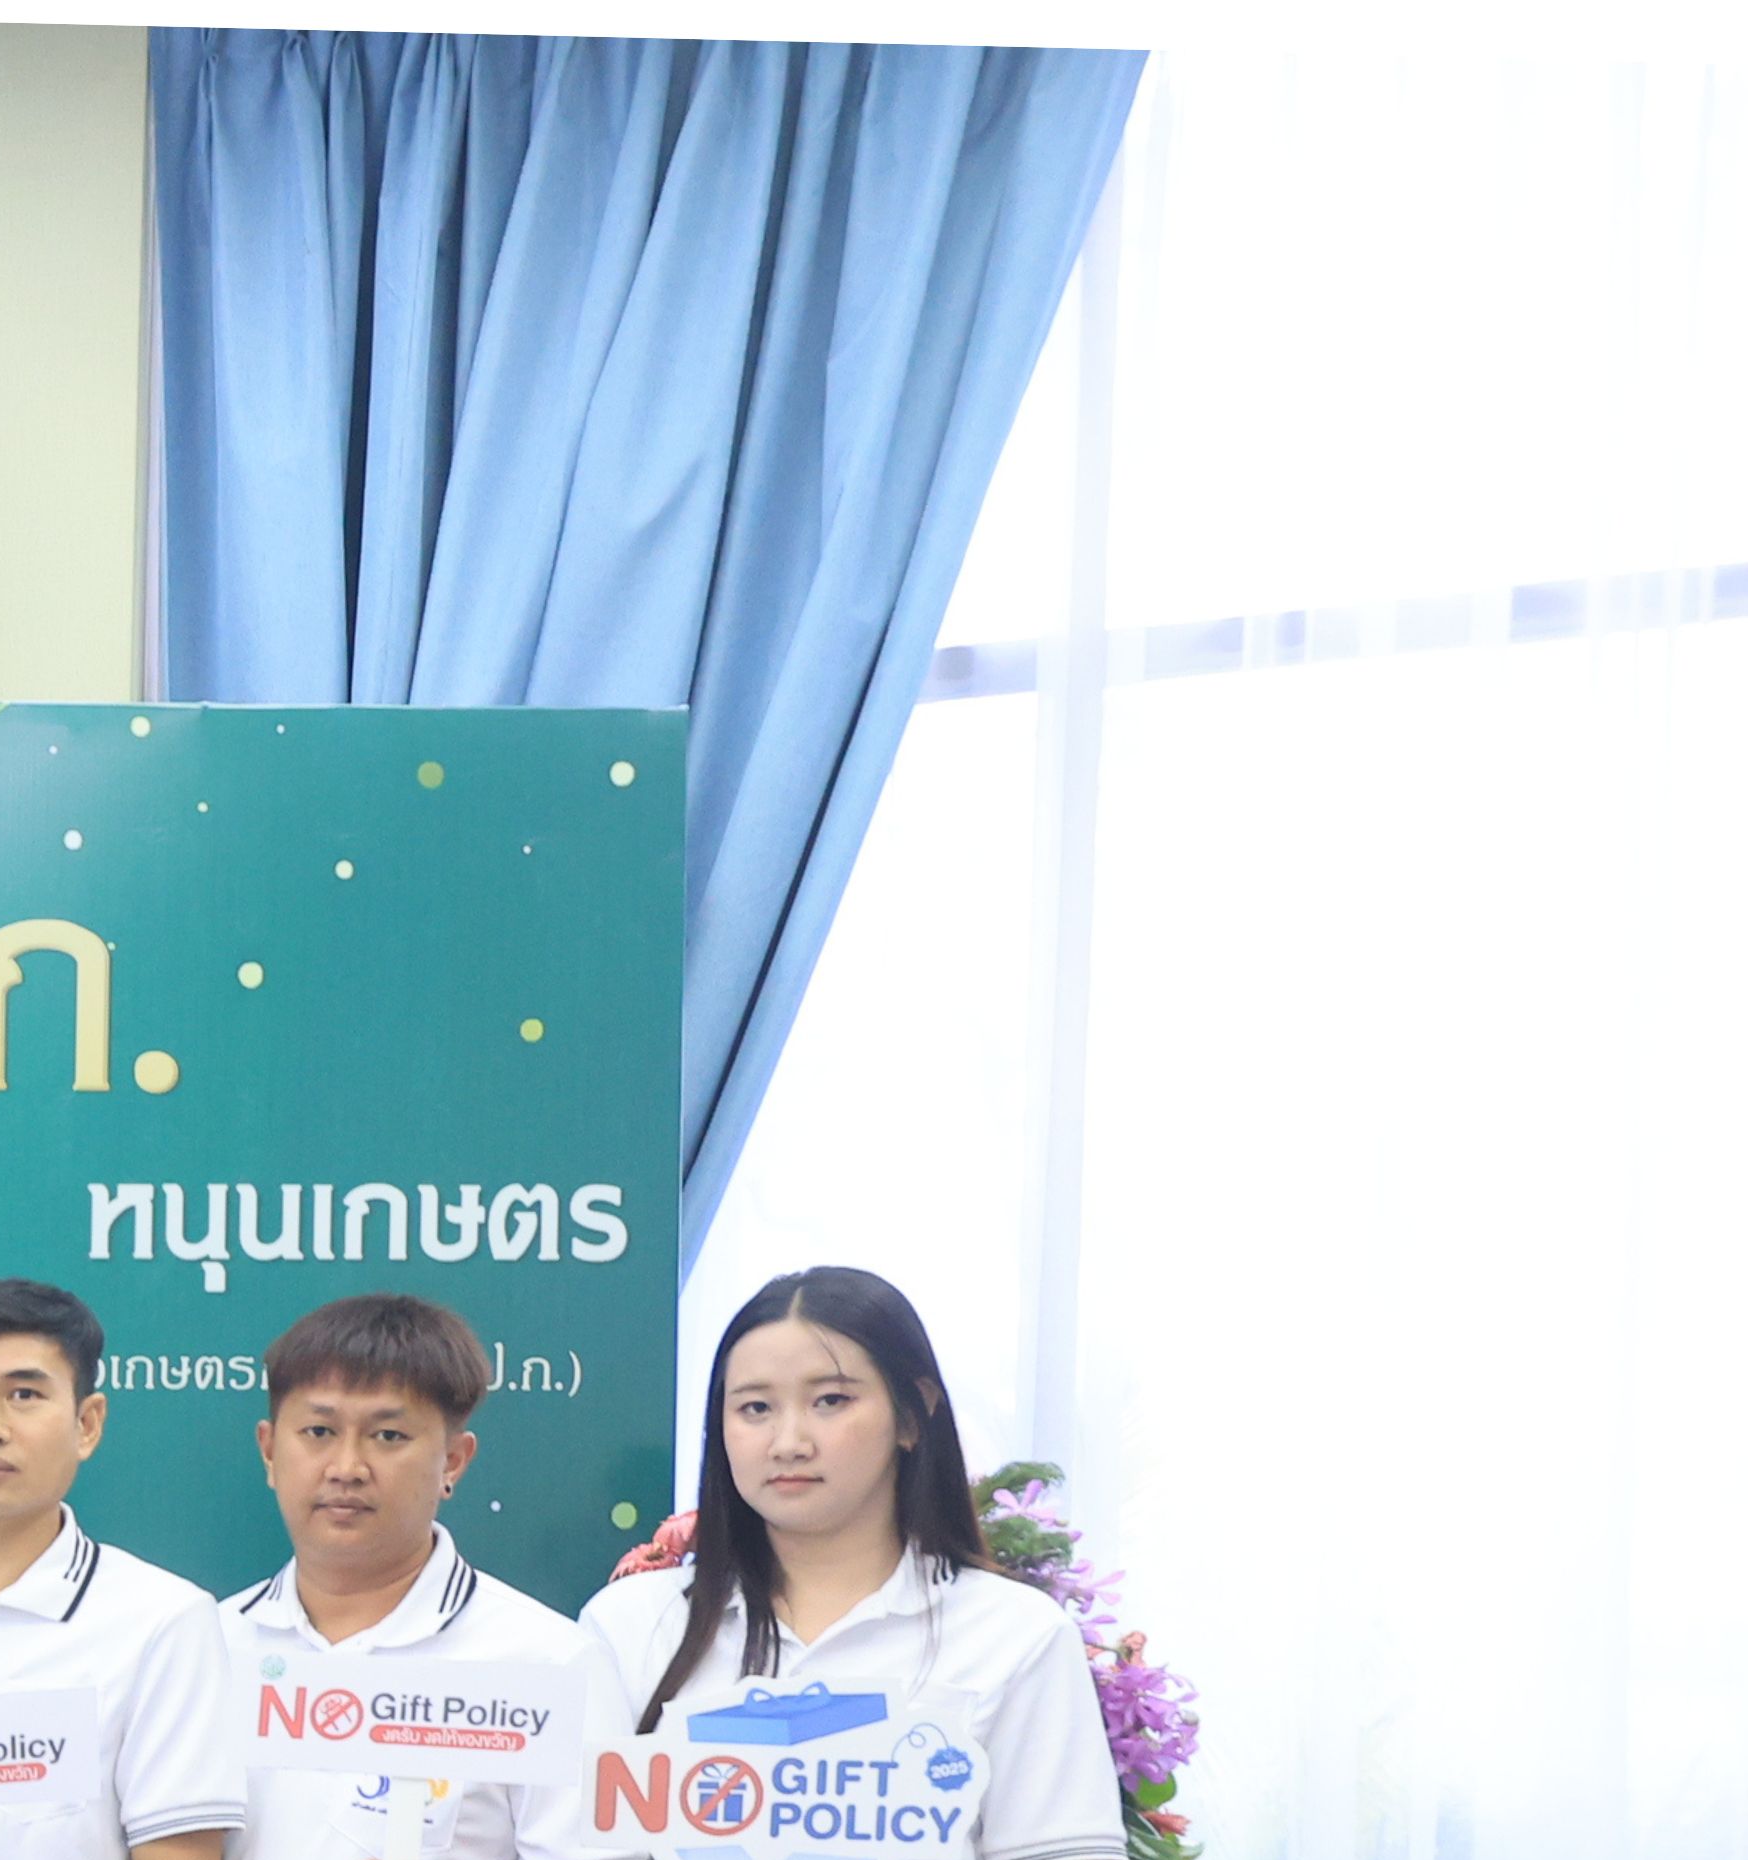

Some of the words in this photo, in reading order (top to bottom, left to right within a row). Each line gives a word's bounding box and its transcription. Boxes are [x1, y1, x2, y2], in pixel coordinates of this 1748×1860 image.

[87, 1182, 628, 1293] หนุนเกษตร
[370, 1693, 432, 1722] Gift
[442, 1697, 550, 1736] Policy
[771, 1757, 899, 1799] GIFT
[930, 1760, 969, 1779] 2025
[770, 1803, 962, 1844] POLICY
